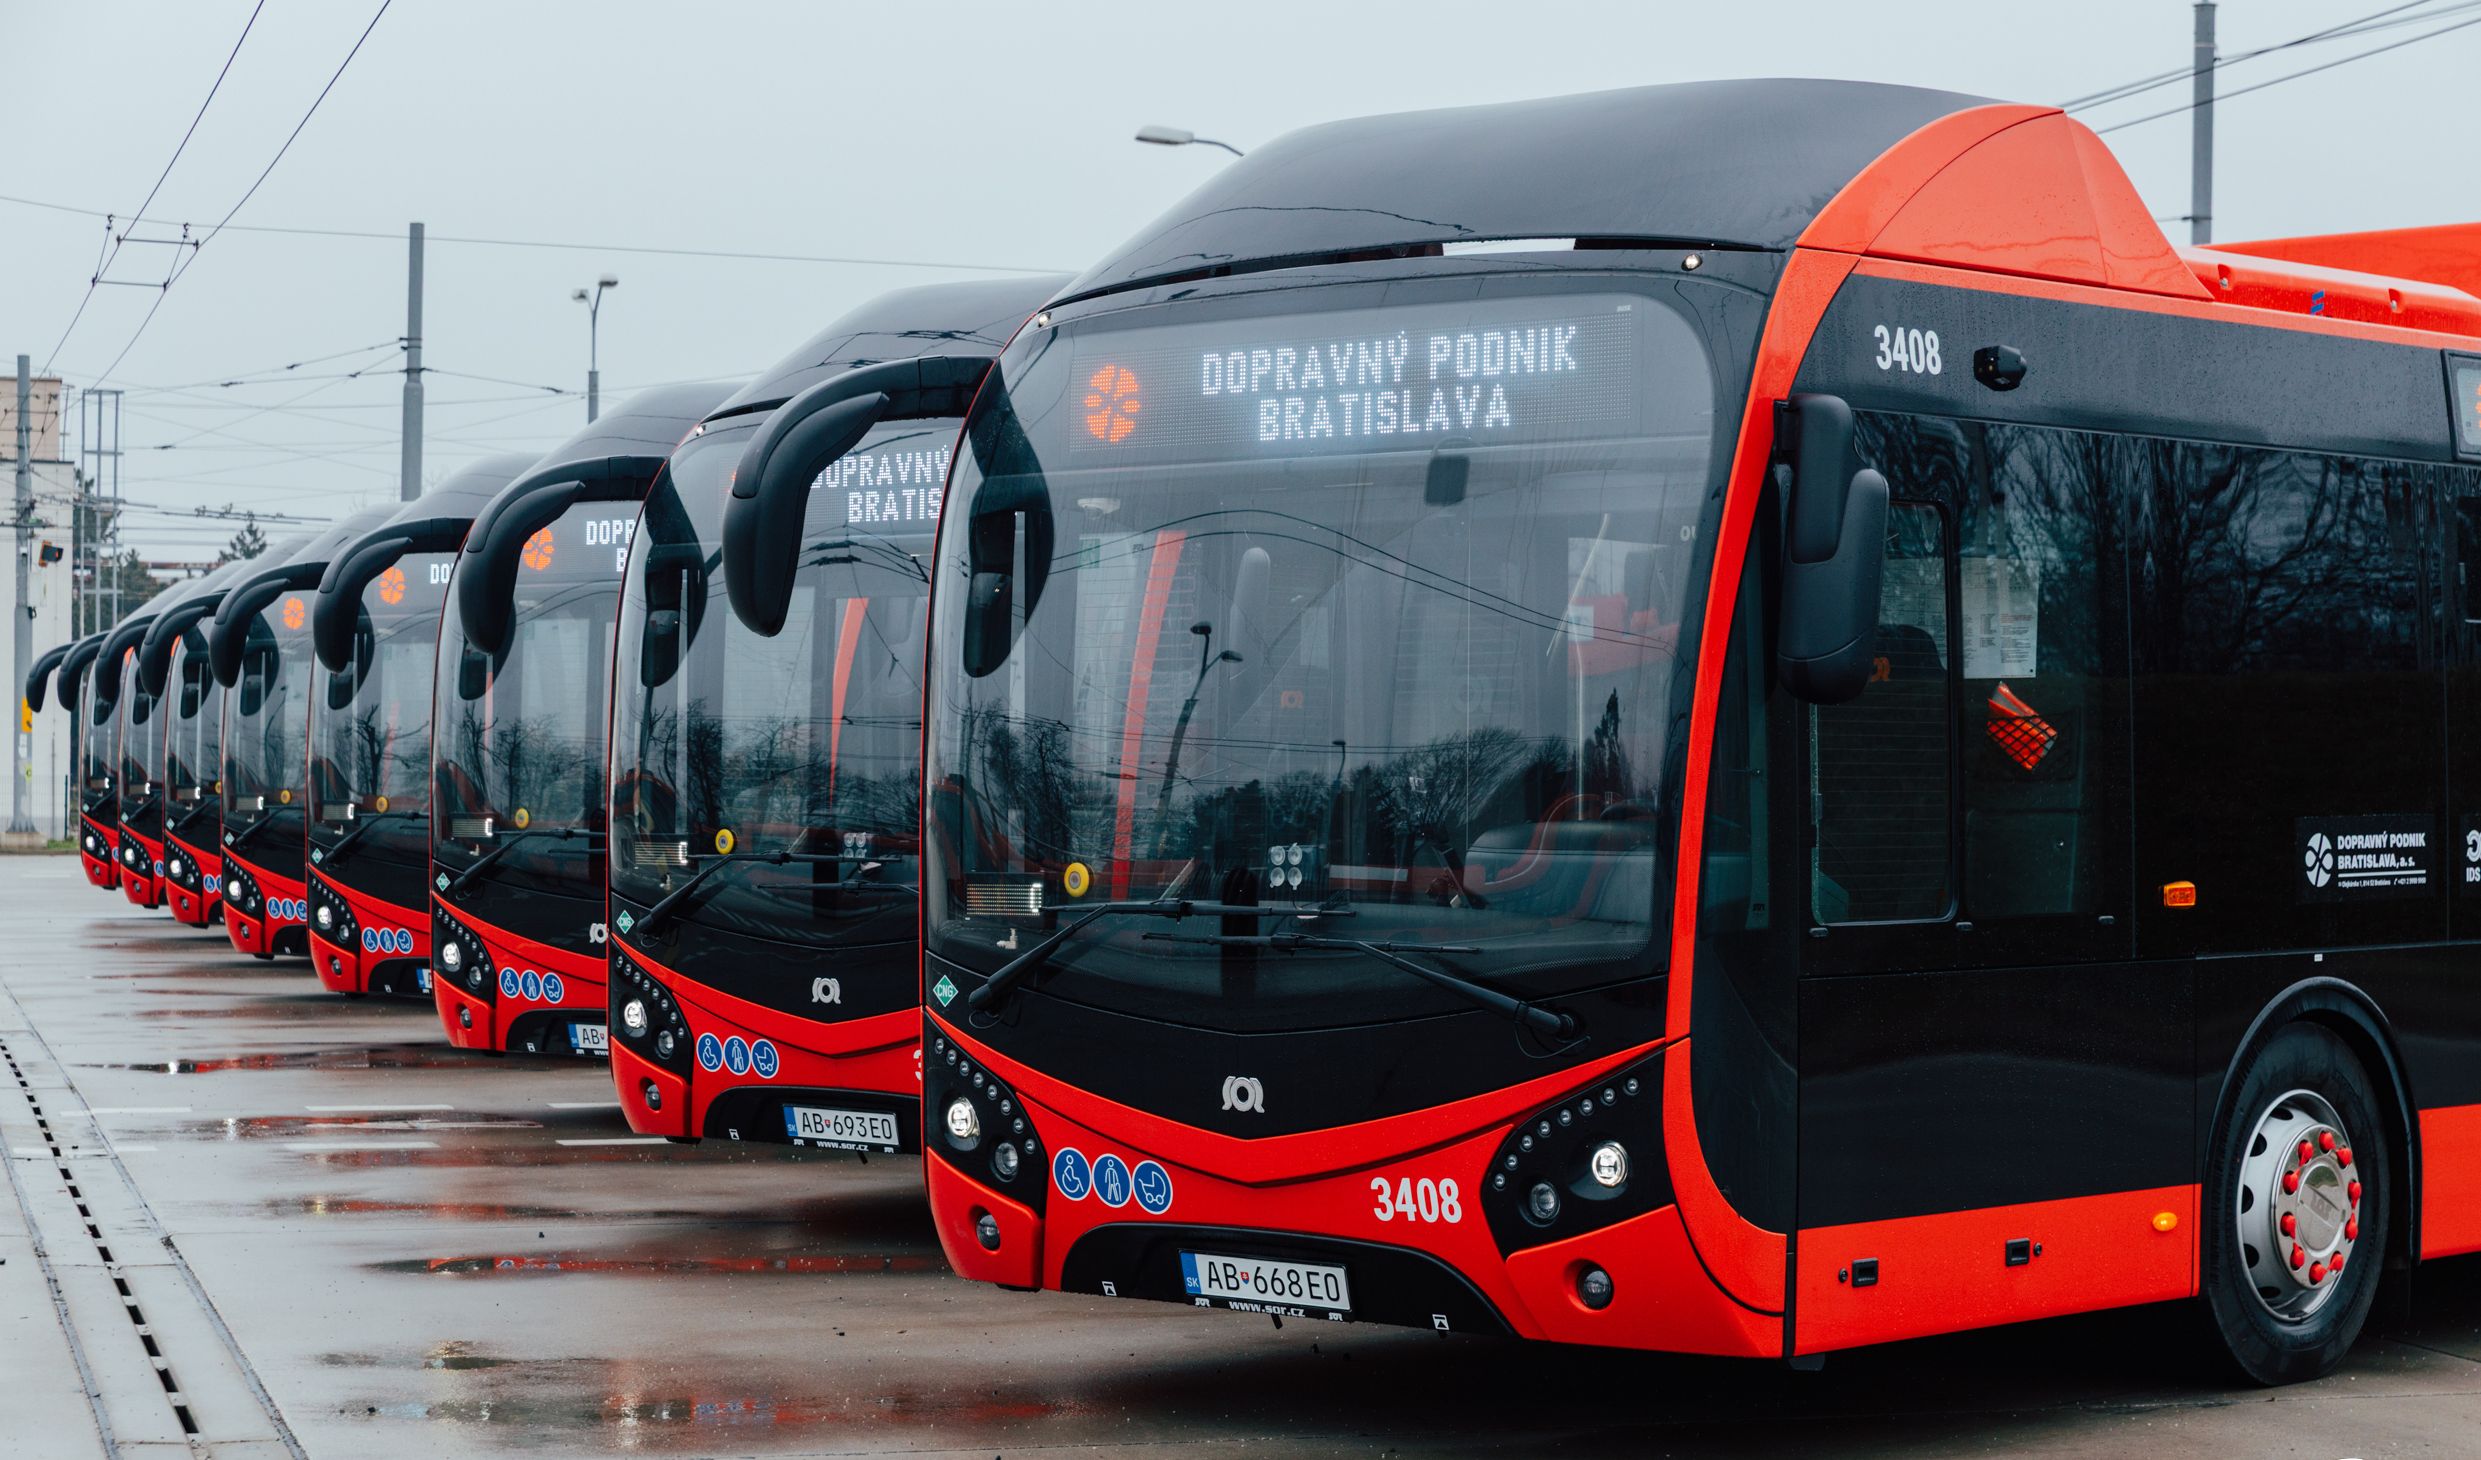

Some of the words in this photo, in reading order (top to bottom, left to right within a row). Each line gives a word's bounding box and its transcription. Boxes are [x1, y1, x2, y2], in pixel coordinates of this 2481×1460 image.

[1202, 330, 1409, 395] DOPRAVNÝ
[1430, 325, 1577, 380] PODNIK
[1874, 324, 1942, 375] 3408
[1259, 383, 1510, 441] BRATISLAVA
[2337, 830, 2388, 850] DOPRAVNÝ
[2389, 832, 2426, 848] PODNIK
[936, 984, 954, 998] CNG
[582, 1028, 600, 1045] AB
[816, 1140, 869, 1152] www.sor.cz
[1370, 1176, 1463, 1224] 3408
[1186, 1276, 1199, 1288] SK
[1208, 1261, 1240, 1291] AB
[1229, 1301, 1306, 1317] www.sor.cz
